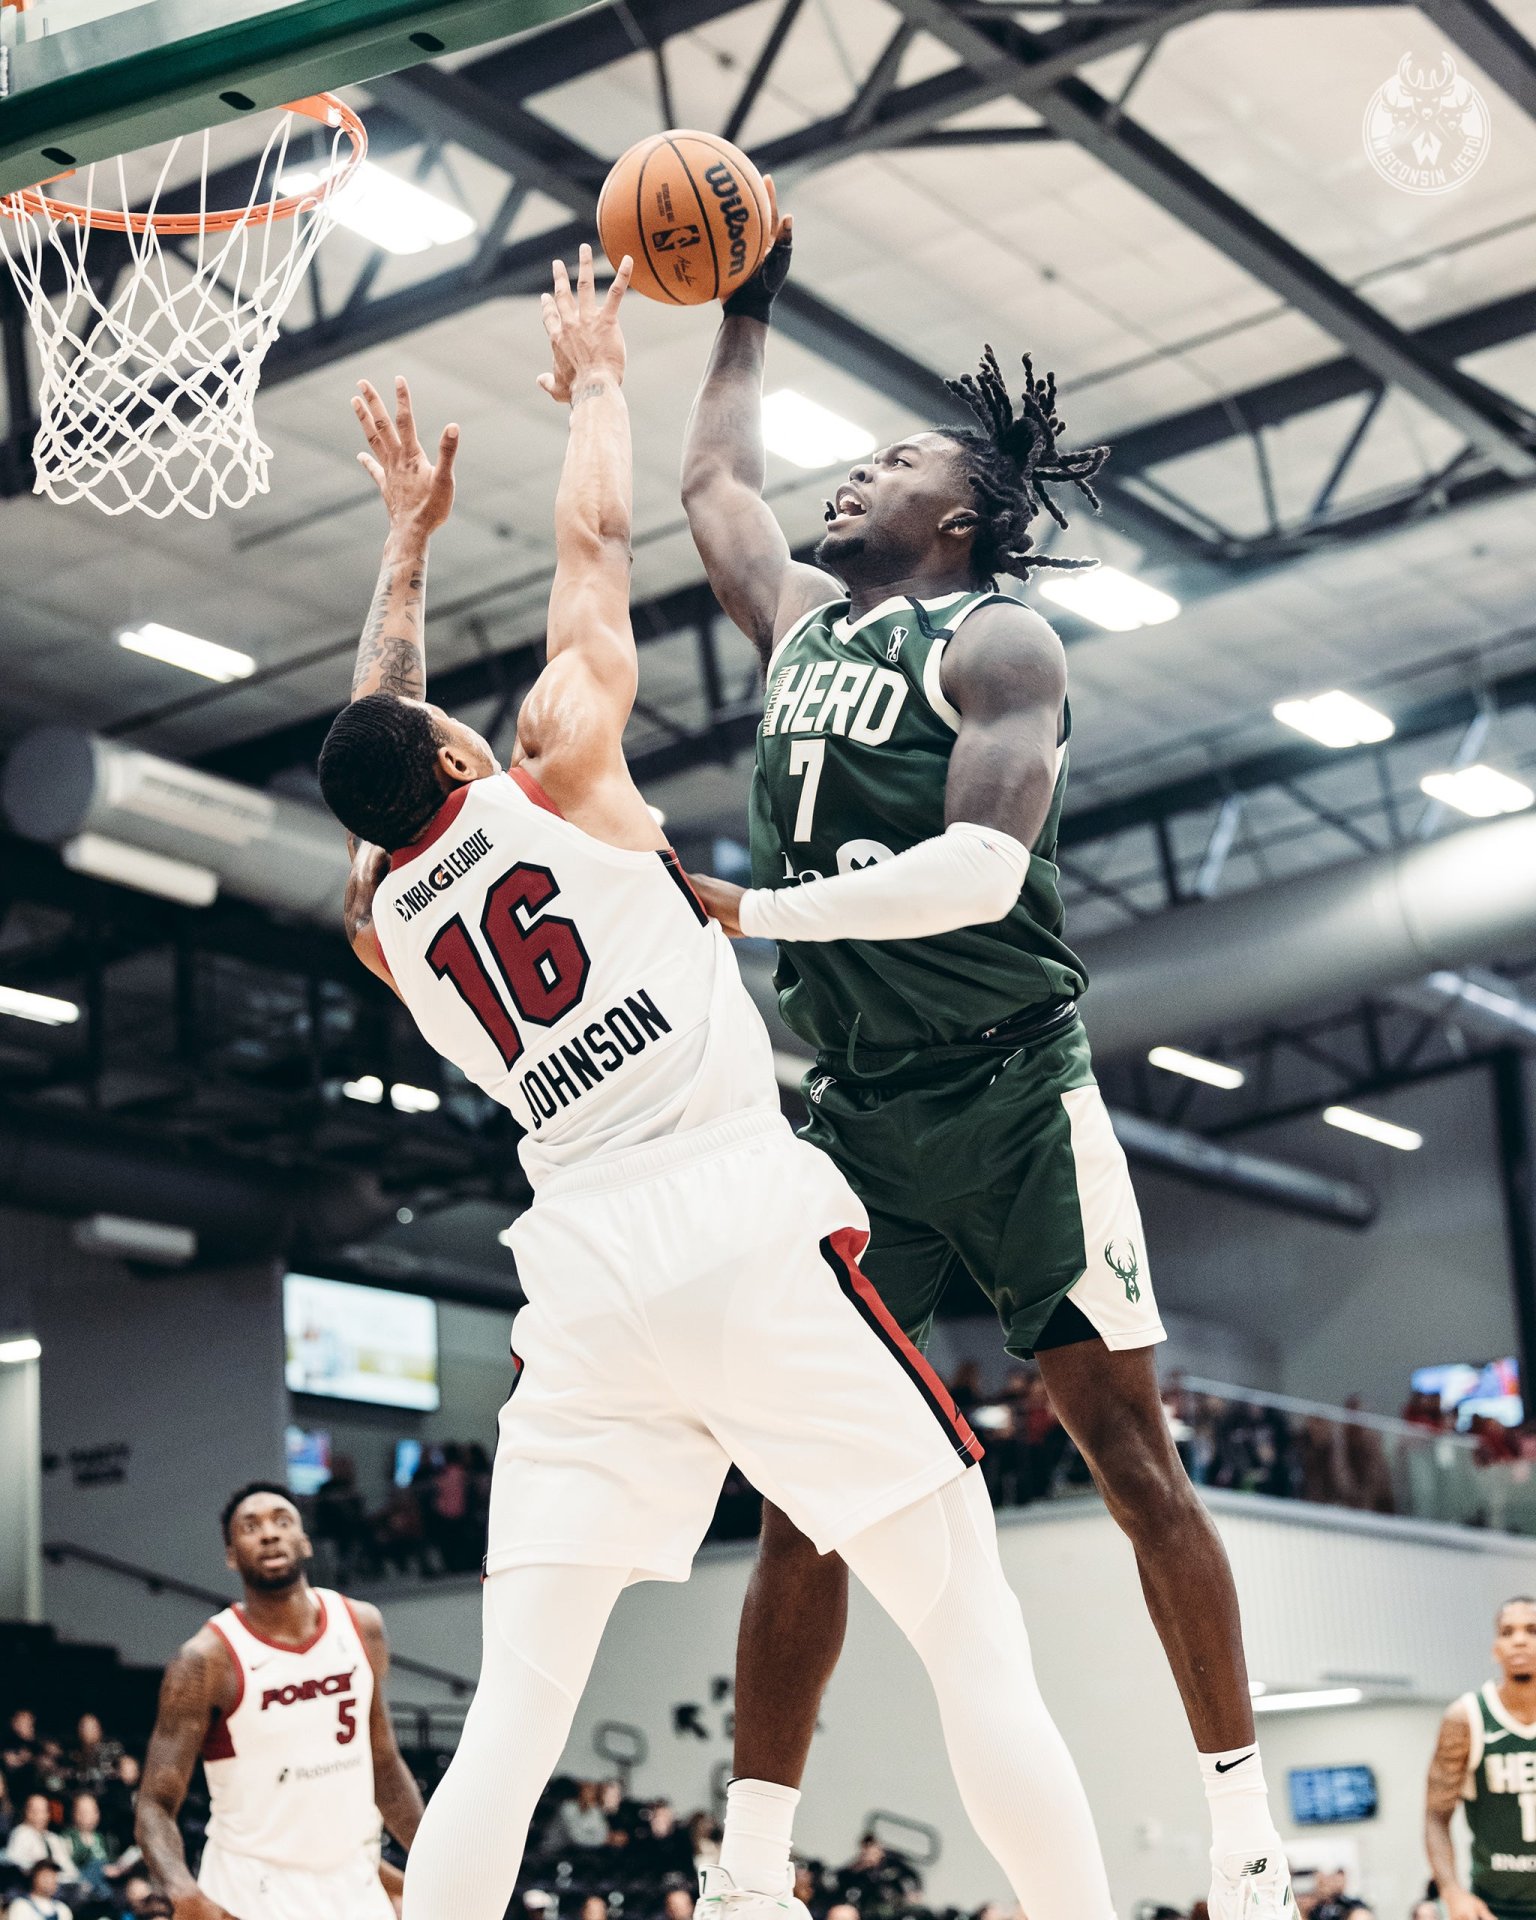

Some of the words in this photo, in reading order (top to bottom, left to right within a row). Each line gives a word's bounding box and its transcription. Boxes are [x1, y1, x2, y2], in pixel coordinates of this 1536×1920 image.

[705, 161, 749, 278] Wilson
[762, 665, 793, 737] WISCONSIN
[765, 660, 909, 747] HERD
[788, 738, 826, 843] 7
[401, 879, 437, 916] NBA
[428, 863, 455, 891] G
[443, 827, 494, 879] LEAGUE
[425, 860, 591, 1073] 16
[519, 988, 673, 1131] JOHNSON
[336, 1698, 356, 1745] 5
[1485, 1752, 1536, 1794] HE
